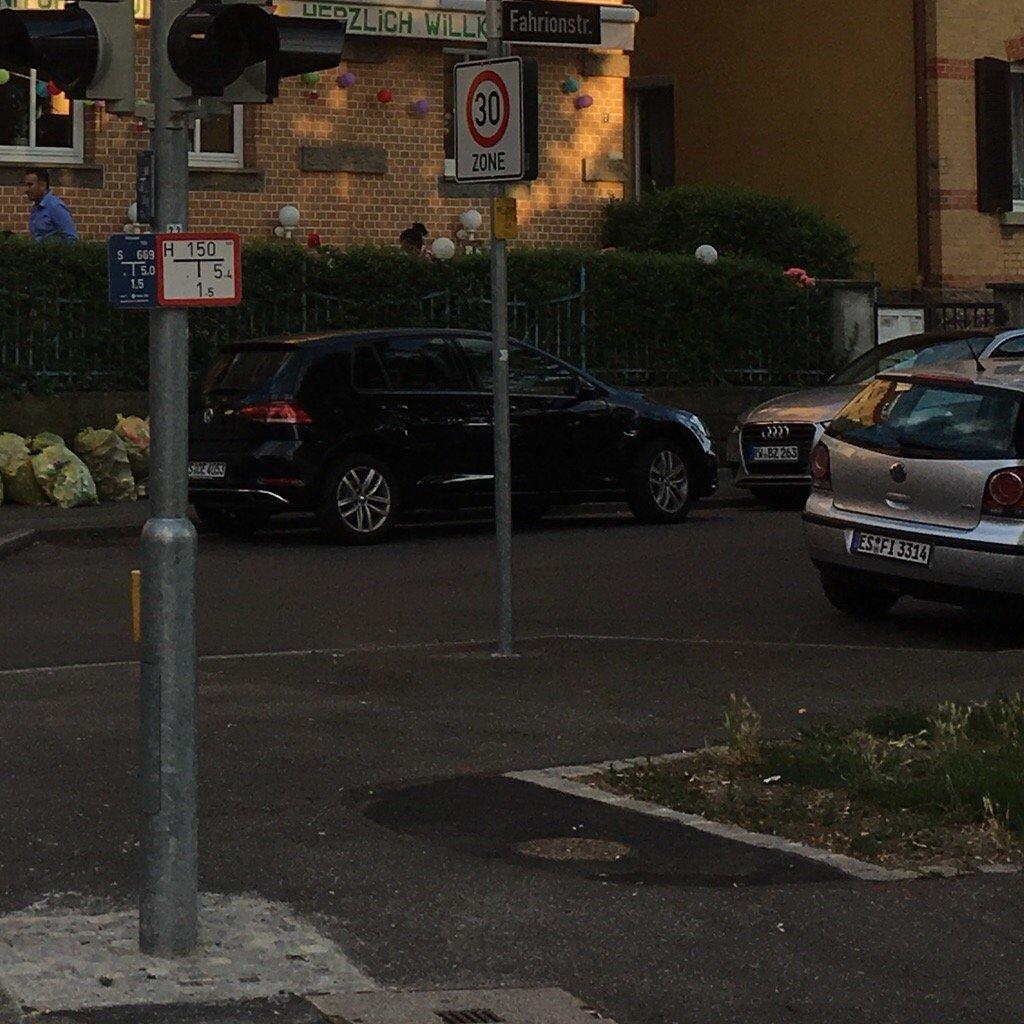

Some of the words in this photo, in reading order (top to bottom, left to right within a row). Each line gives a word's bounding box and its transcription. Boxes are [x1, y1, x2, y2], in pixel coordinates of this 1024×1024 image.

[509, 9, 594, 35] Fahrionstr.
[474, 90, 501, 126] 30
[472, 152, 506, 172] ZONE
[117, 250, 124, 260] S
[164, 242, 174, 257] H
[187, 241, 216, 257] 150
[859, 535, 874, 551] ES
[897, 541, 927, 561] 3314
